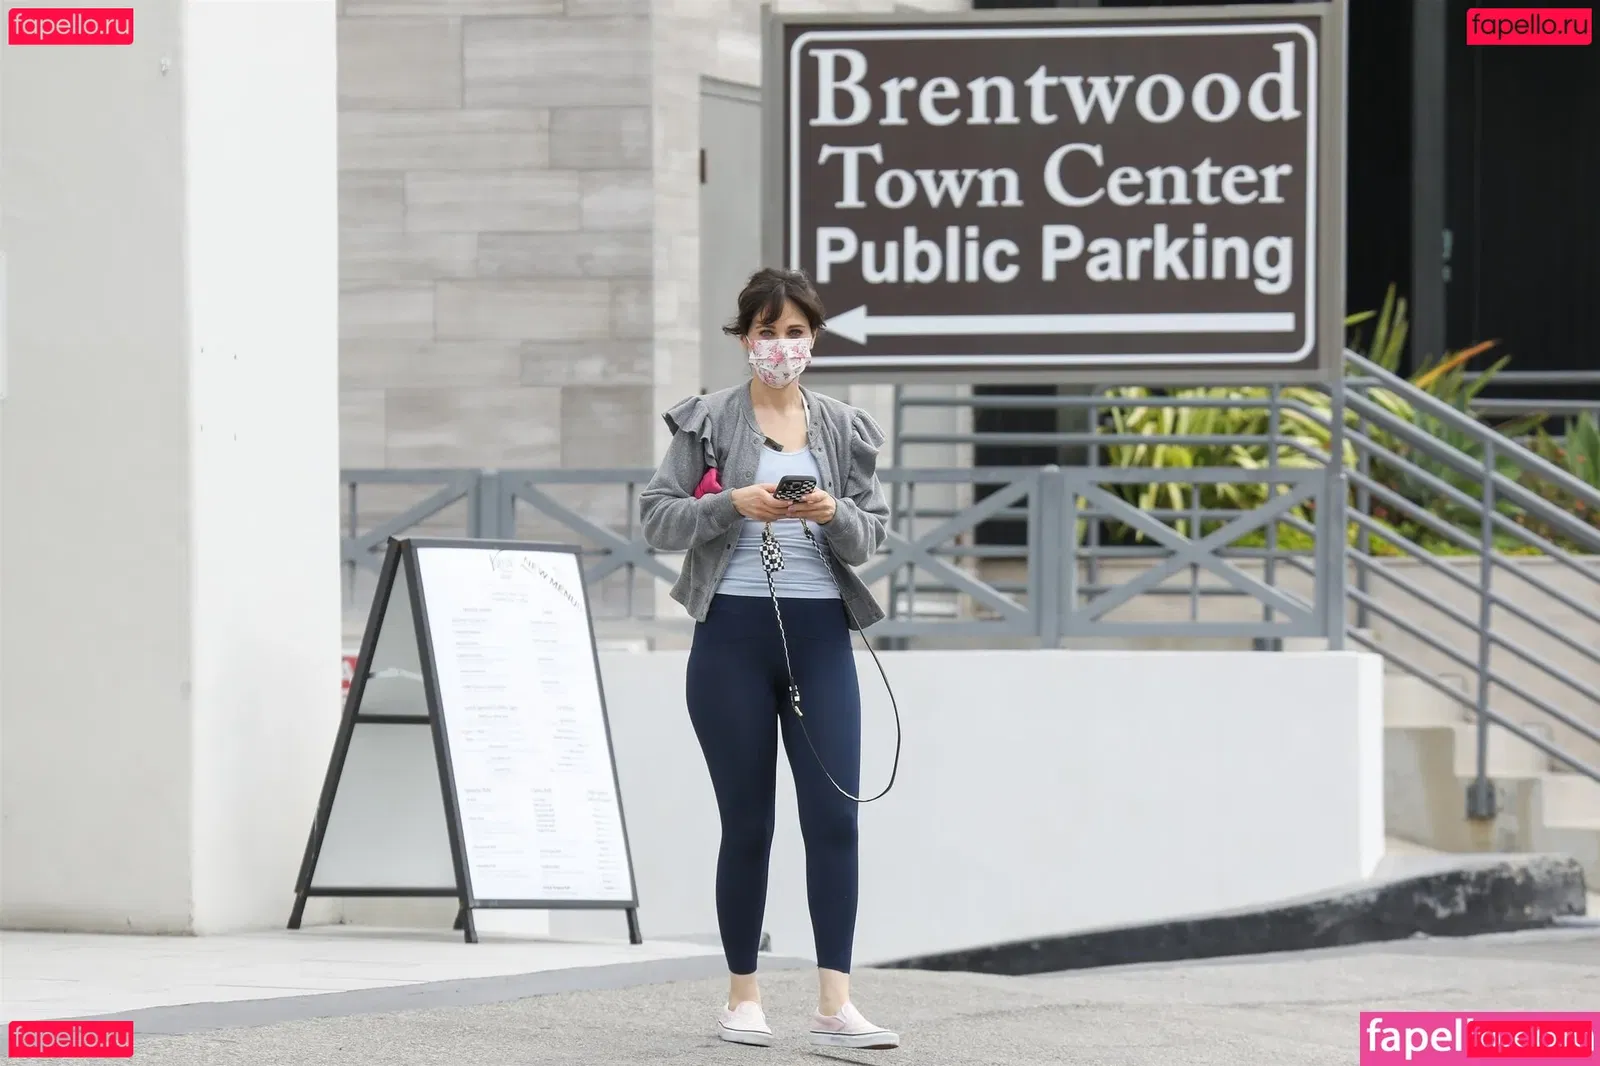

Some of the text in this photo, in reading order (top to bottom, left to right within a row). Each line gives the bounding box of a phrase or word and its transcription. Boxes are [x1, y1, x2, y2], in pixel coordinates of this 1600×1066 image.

[808, 41, 1302, 126] Brentwood
[818, 142, 1293, 209] Town Center
[815, 223, 1293, 295] Public Parking
